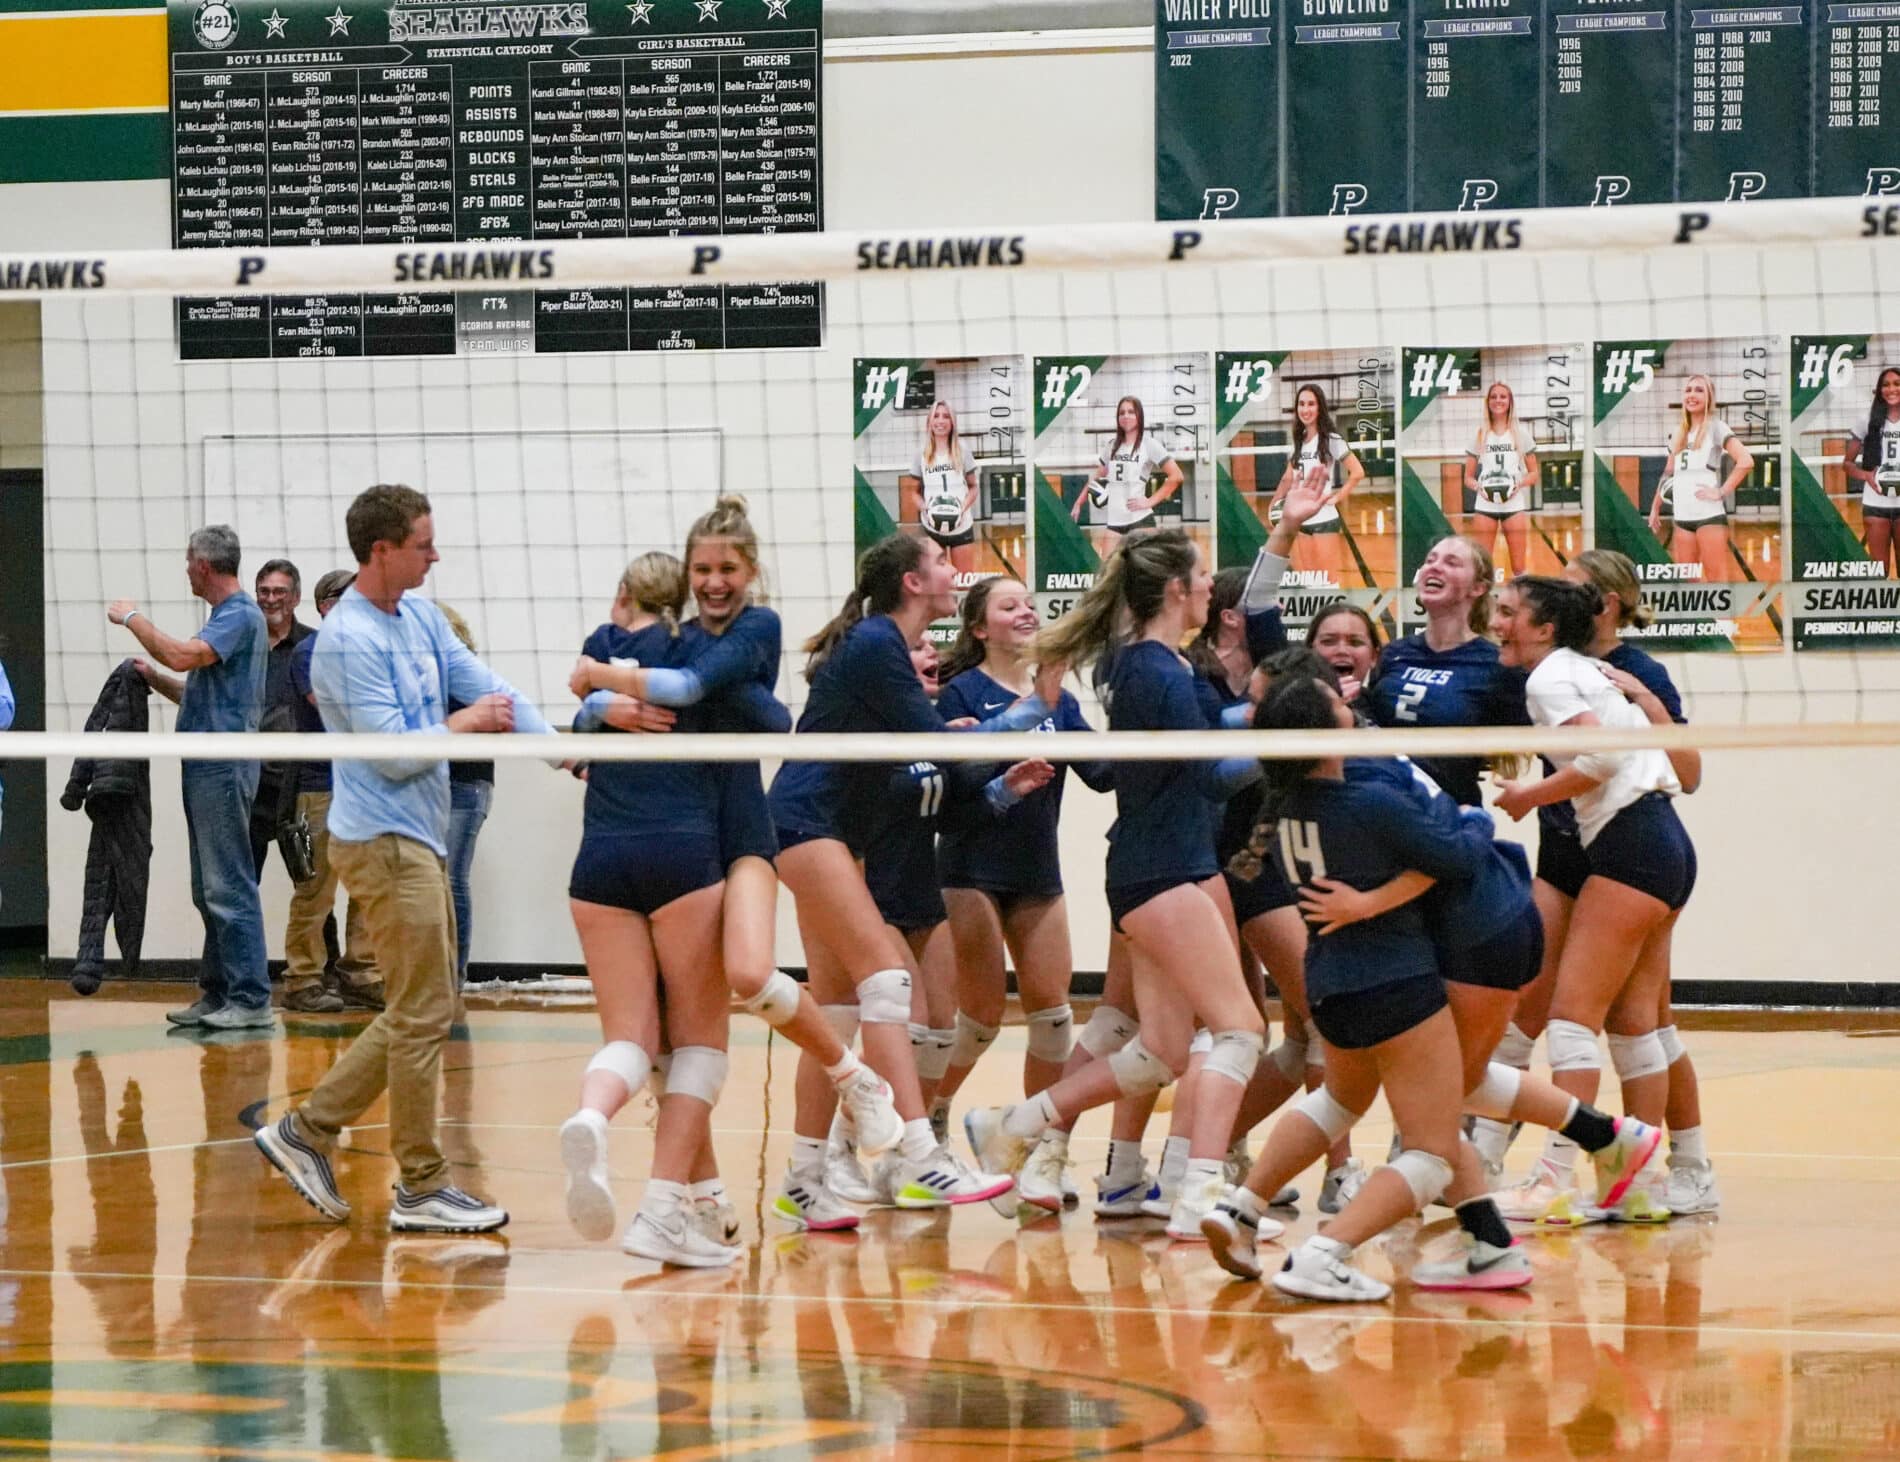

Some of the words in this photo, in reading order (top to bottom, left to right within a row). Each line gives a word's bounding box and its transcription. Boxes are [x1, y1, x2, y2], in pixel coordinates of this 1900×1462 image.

[1165, 0, 1221, 21] WATER
[1228, 0, 1271, 19] POLO
[1711, 13, 1738, 23] LEAGUE
[1739, 11, 1783, 22] CHAMPIONS
[1848, 7, 1875, 18] LEAGUE
[202, 15, 230, 29] #21
[389, 3, 591, 42] SEAHAWKS
[1443, 23, 1470, 33] LEAGUE
[1471, 21, 1513, 32] CHAMPIONS
[1575, 18, 1602, 28] LEAGUE
[1604, 16, 1647, 27] CHAMPIONS
[1185, 34, 1210, 44] LEAGUE
[1211, 32, 1253, 43] CHAMPIONS
[1313, 29, 1339, 39] LEAGUE
[1340, 26, 1382, 38] CHAMPIONS
[1695, 33, 1714, 45] 1981
[1721, 32, 1744, 44] 1988
[1749, 31, 1771, 43] 2013
[1832, 27, 1852, 40] 1981
[1857, 26, 1882, 39] 2006
[638, 40, 674, 50] GIRL'S
[676, 37, 746, 48] BASKETBALL
[1428, 42, 1448, 55] 1991
[1559, 38, 1581, 50] 1996
[1831, 42, 1852, 54] 1982
[1858, 41, 1882, 53] 2008
[226, 54, 262, 65] BOY'S
[265, 51, 344, 63] BASKETBALL
[427, 45, 494, 58] STATISTICAL
[495, 44, 554, 57] CATEGORY
[1558, 52, 1582, 64] 2005
[1694, 48, 1715, 59] 1982
[1720, 46, 1744, 58] 2006
[651, 58, 692, 70] SEASON
[743, 54, 791, 67] CAREERS
[1170, 54, 1192, 66] 2022
[1427, 57, 1449, 69] 1996
[1831, 57, 1852, 68] 1983
[1857, 56, 1882, 68] 2009
[382, 68, 428, 80] CAREERS
[562, 62, 591, 74] GAME
[1558, 66, 1582, 79] 2006
[1694, 62, 1715, 74] 1983
[1720, 61, 1744, 73] 2008
[203, 75, 232, 85] GAME
[292, 71, 331, 83] SEASON
[571, 77, 581, 87] 41
[1426, 71, 1450, 83] 2006
[1694, 77, 1715, 88] 1984
[1720, 76, 1744, 87] 2009
[1830, 72, 1852, 83] 1986
[1859, 71, 1880, 82] 2010
[469, 85, 513, 99] POINTS
[747, 80, 774, 90] Frazier
[1426, 85, 1450, 97] 2007
[1559, 81, 1581, 94] 2019
[1830, 86, 1851, 98] 1987
[1859, 85, 1878, 96] 2011
[269, 98, 276, 106] J.
[277, 97, 321, 107] McLaughlin
[361, 94, 369, 103] J.
[370, 93, 414, 104] McLaughlin
[1694, 91, 1715, 102] 1985
[1721, 90, 1742, 101] 2010
[1694, 105, 1715, 117] 1986
[1722, 104, 1741, 116] 2011
[1830, 101, 1852, 112] 1988
[1859, 100, 1880, 111] 2012
[466, 107, 517, 121] ASSISTS
[1829, 115, 1853, 127] 2005
[1858, 114, 1879, 126] 2013
[1694, 120, 1714, 132] 1987
[1721, 119, 1742, 130] 2012
[460, 129, 525, 144] REBOUNDS
[469, 152, 516, 165] BLOCKS
[469, 173, 516, 187] STEALS
[1862, 168, 1900, 199] P
[1591, 175, 1631, 209] P
[1725, 171, 1767, 204] P
[490, 194, 525, 208] MADE
[1328, 183, 1368, 217] P
[1458, 179, 1498, 213] P
[1200, 188, 1240, 221] P
[1673, 212, 1711, 244] P
[1345, 219, 1523, 255] SEAHAWKS
[1168, 230, 1203, 260] P
[690, 245, 722, 275] P
[857, 236, 1025, 270] SEAHAWKS
[236, 257, 266, 285] P
[394, 250, 555, 282] SEAHAWKS
[0, 261, 106, 290] HAWKS
[482, 297, 508, 310] FT%
[1602, 349, 1656, 393] #5
[1799, 343, 1855, 389] #6
[1224, 359, 1273, 403] #3
[1409, 353, 1462, 397] #4
[861, 366, 909, 409] #1
[1042, 365, 1093, 409] #2
[1547, 354, 1570, 428] 2024
[1743, 346, 1767, 423] 2025
[989, 364, 1012, 438] 2024
[1174, 363, 1196, 437] 2024
[1356, 357, 1382, 433] 2026
[1887, 441, 1897, 458] 6
[1495, 453, 1504, 470] 4
[1680, 452, 1688, 471] 5
[1116, 463, 1124, 481] 2
[941, 473, 948, 492] 1
[1646, 563, 1703, 579] EPSTEIN
[1803, 561, 1838, 578] ZIAH
[1839, 561, 1885, 577] SNEVA
[1046, 573, 1095, 589] EVALYN
[1279, 570, 1331, 586] RDINAL
[1639, 589, 1732, 612] AHAWKS
[1804, 588, 1900, 611] SEAHAW
[1668, 623, 1696, 636] HIGH
[1804, 621, 1865, 635] PENINSULA
[1866, 621, 1894, 634] HIGH
[1401, 666, 1454, 685] TIDES
[1395, 682, 1428, 721] 2
[920, 774, 943, 817] 11
[1277, 817, 1327, 884] 14
